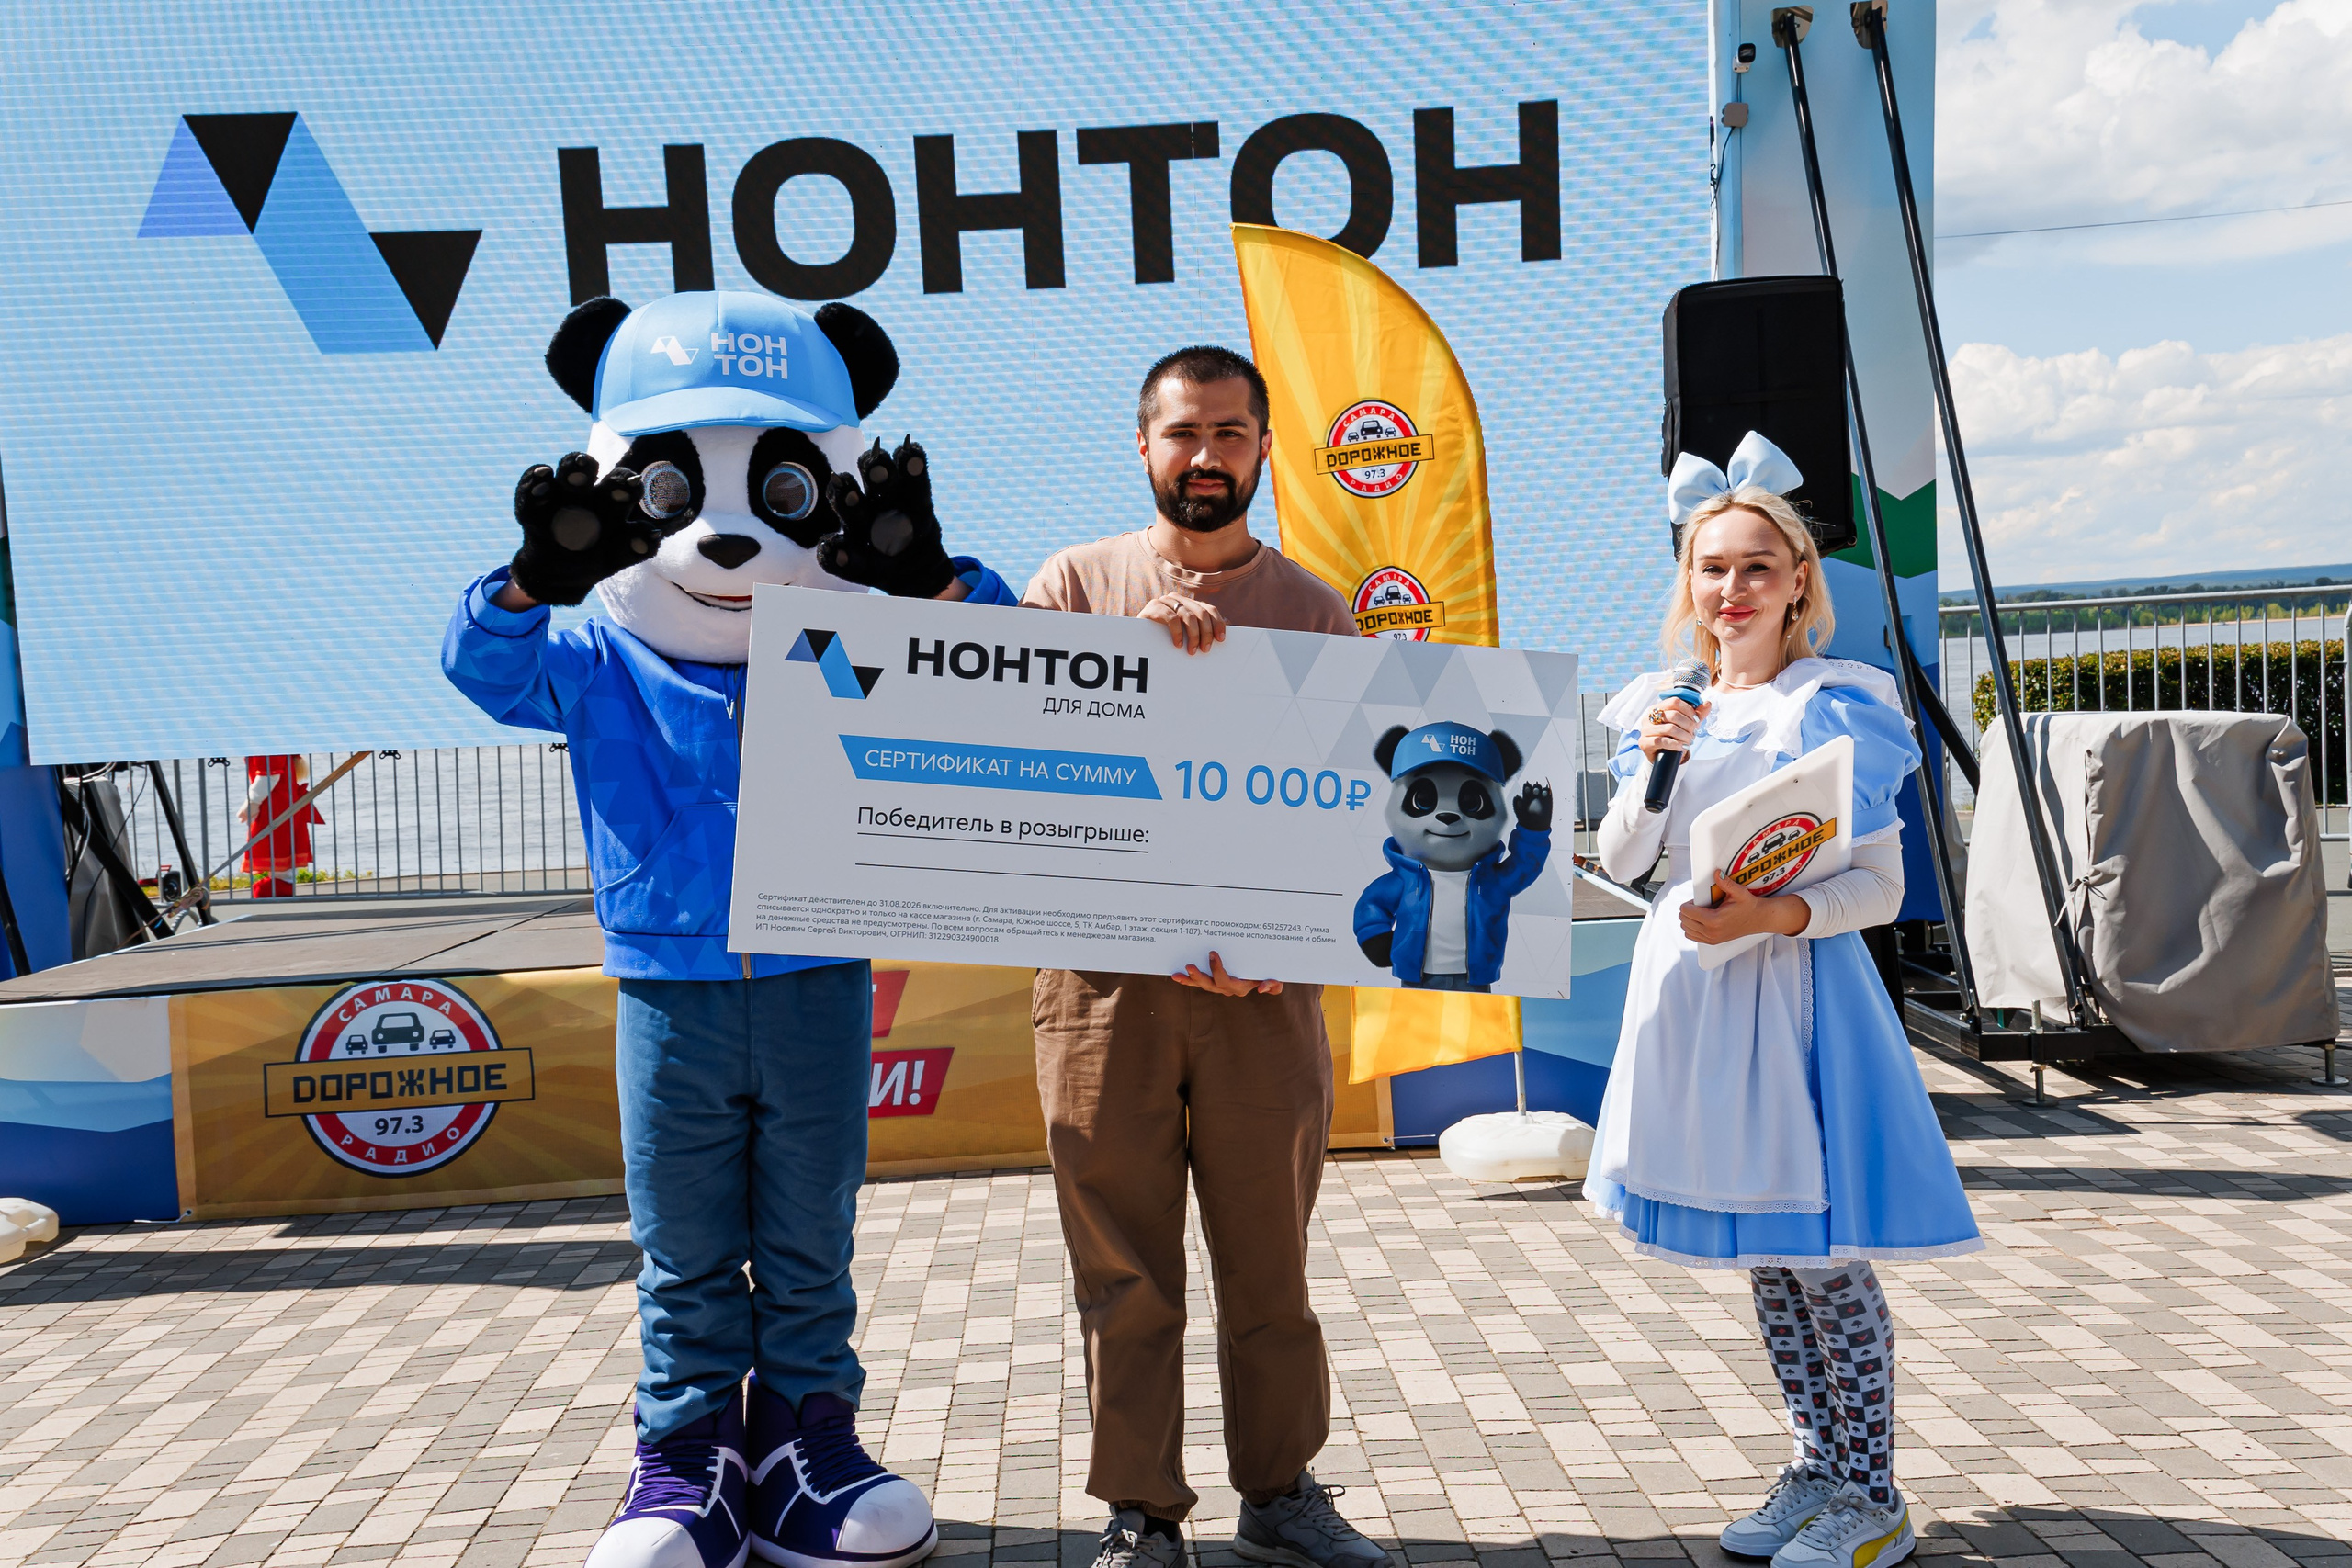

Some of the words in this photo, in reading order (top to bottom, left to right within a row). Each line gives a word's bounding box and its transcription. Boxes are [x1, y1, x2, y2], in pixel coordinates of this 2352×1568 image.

[556, 98, 1563, 307] НОНТОН
[710, 332, 787, 356] НОН
[714, 354, 788, 379] ТОН
[1342, 407, 1395, 428] САМАРА
[1326, 442, 1421, 468] ДОРОЖНОЕ
[1350, 472, 1403, 492] РАДИО
[1364, 468, 1385, 479] 97.3
[907, 637, 1149, 694] НОНТОН
[1042, 697, 1082, 715] ДЛЯ
[1086, 701, 1146, 719] ДОМА
[1450, 734, 1476, 746] НОН
[1450, 744, 1476, 755] ТОН
[865, 749, 1013, 776] СЕРТИФИКАТ
[1019, 761, 1049, 780] НА
[1055, 763, 1136, 784] СУММУ
[1175, 760, 1228, 801] 10
[857, 807, 994, 833] Победитель
[1001, 819, 1012, 833] в
[1019, 821, 1149, 844] розыгрыше:
[1745, 818, 1800, 854] САМАРА
[1736, 829, 1824, 885] ОРОЖНОЕ
[1758, 863, 1802, 894] АДИО
[1762, 867, 1785, 885] 97.3
[757, 893, 808, 904] Сертификат
[808, 896, 865, 907] действителен
[879, 900, 922, 909] 31.08.2026
[922, 904, 981, 913] включительно.
[982, 907, 999, 915] Для
[1000, 908, 1041, 918] активации
[1043, 910, 1091, 920] необходимо
[1092, 914, 1138, 923] предъявить
[1158, 918, 1204, 928] сертификат
[1210, 921, 1261, 931] промокодом:
[1262, 923, 1303, 932] 651257243.
[1305, 926, 1330, 935] Сумма
[757, 904, 809, 913] списывается
[811, 908, 861, 917] однократно
[933, 914, 971, 922] магазина
[972, 915, 981, 924] (г.
[982, 916, 1015, 926] Самара,
[1016, 918, 1046, 927] Южное
[1046, 921, 1073, 930] шоссе,
[1082, 921, 1093, 930] ТК
[1094, 922, 1122, 932] Амбар,
[1128, 926, 1149, 934] этаж,
[1150, 927, 1178, 935] секция
[1179, 927, 1202, 937] 1-187).
[1204, 929, 1245, 938] Частичное
[1246, 932, 1304, 942] использование
[1311, 934, 1336, 943] обмен
[767, 915, 810, 923] денежные
[812, 917, 850, 925] средства
[863, 920, 930, 931] предусмотрены.
[931, 922, 943, 931] По
[965, 926, 1005, 934] вопросам
[1006, 926, 1059, 937] обращайтесь
[1066, 931, 1116, 942] менеджерам
[1118, 934, 1157, 942] магазина.
[755, 923, 768, 931] ИП
[770, 924, 806, 933] Носевич
[807, 926, 837, 936] Сергей
[838, 928, 888, 939] Викторович,
[890, 931, 927, 940] ОГРНИП:
[929, 932, 1001, 943] 312290324900018.
[338, 987, 453, 1022] САМАРА
[292, 1063, 508, 1103] ДОРОЖНОЕ
[374, 1115, 424, 1135] 97.3
[340, 1126, 460, 1164] РАДИО
